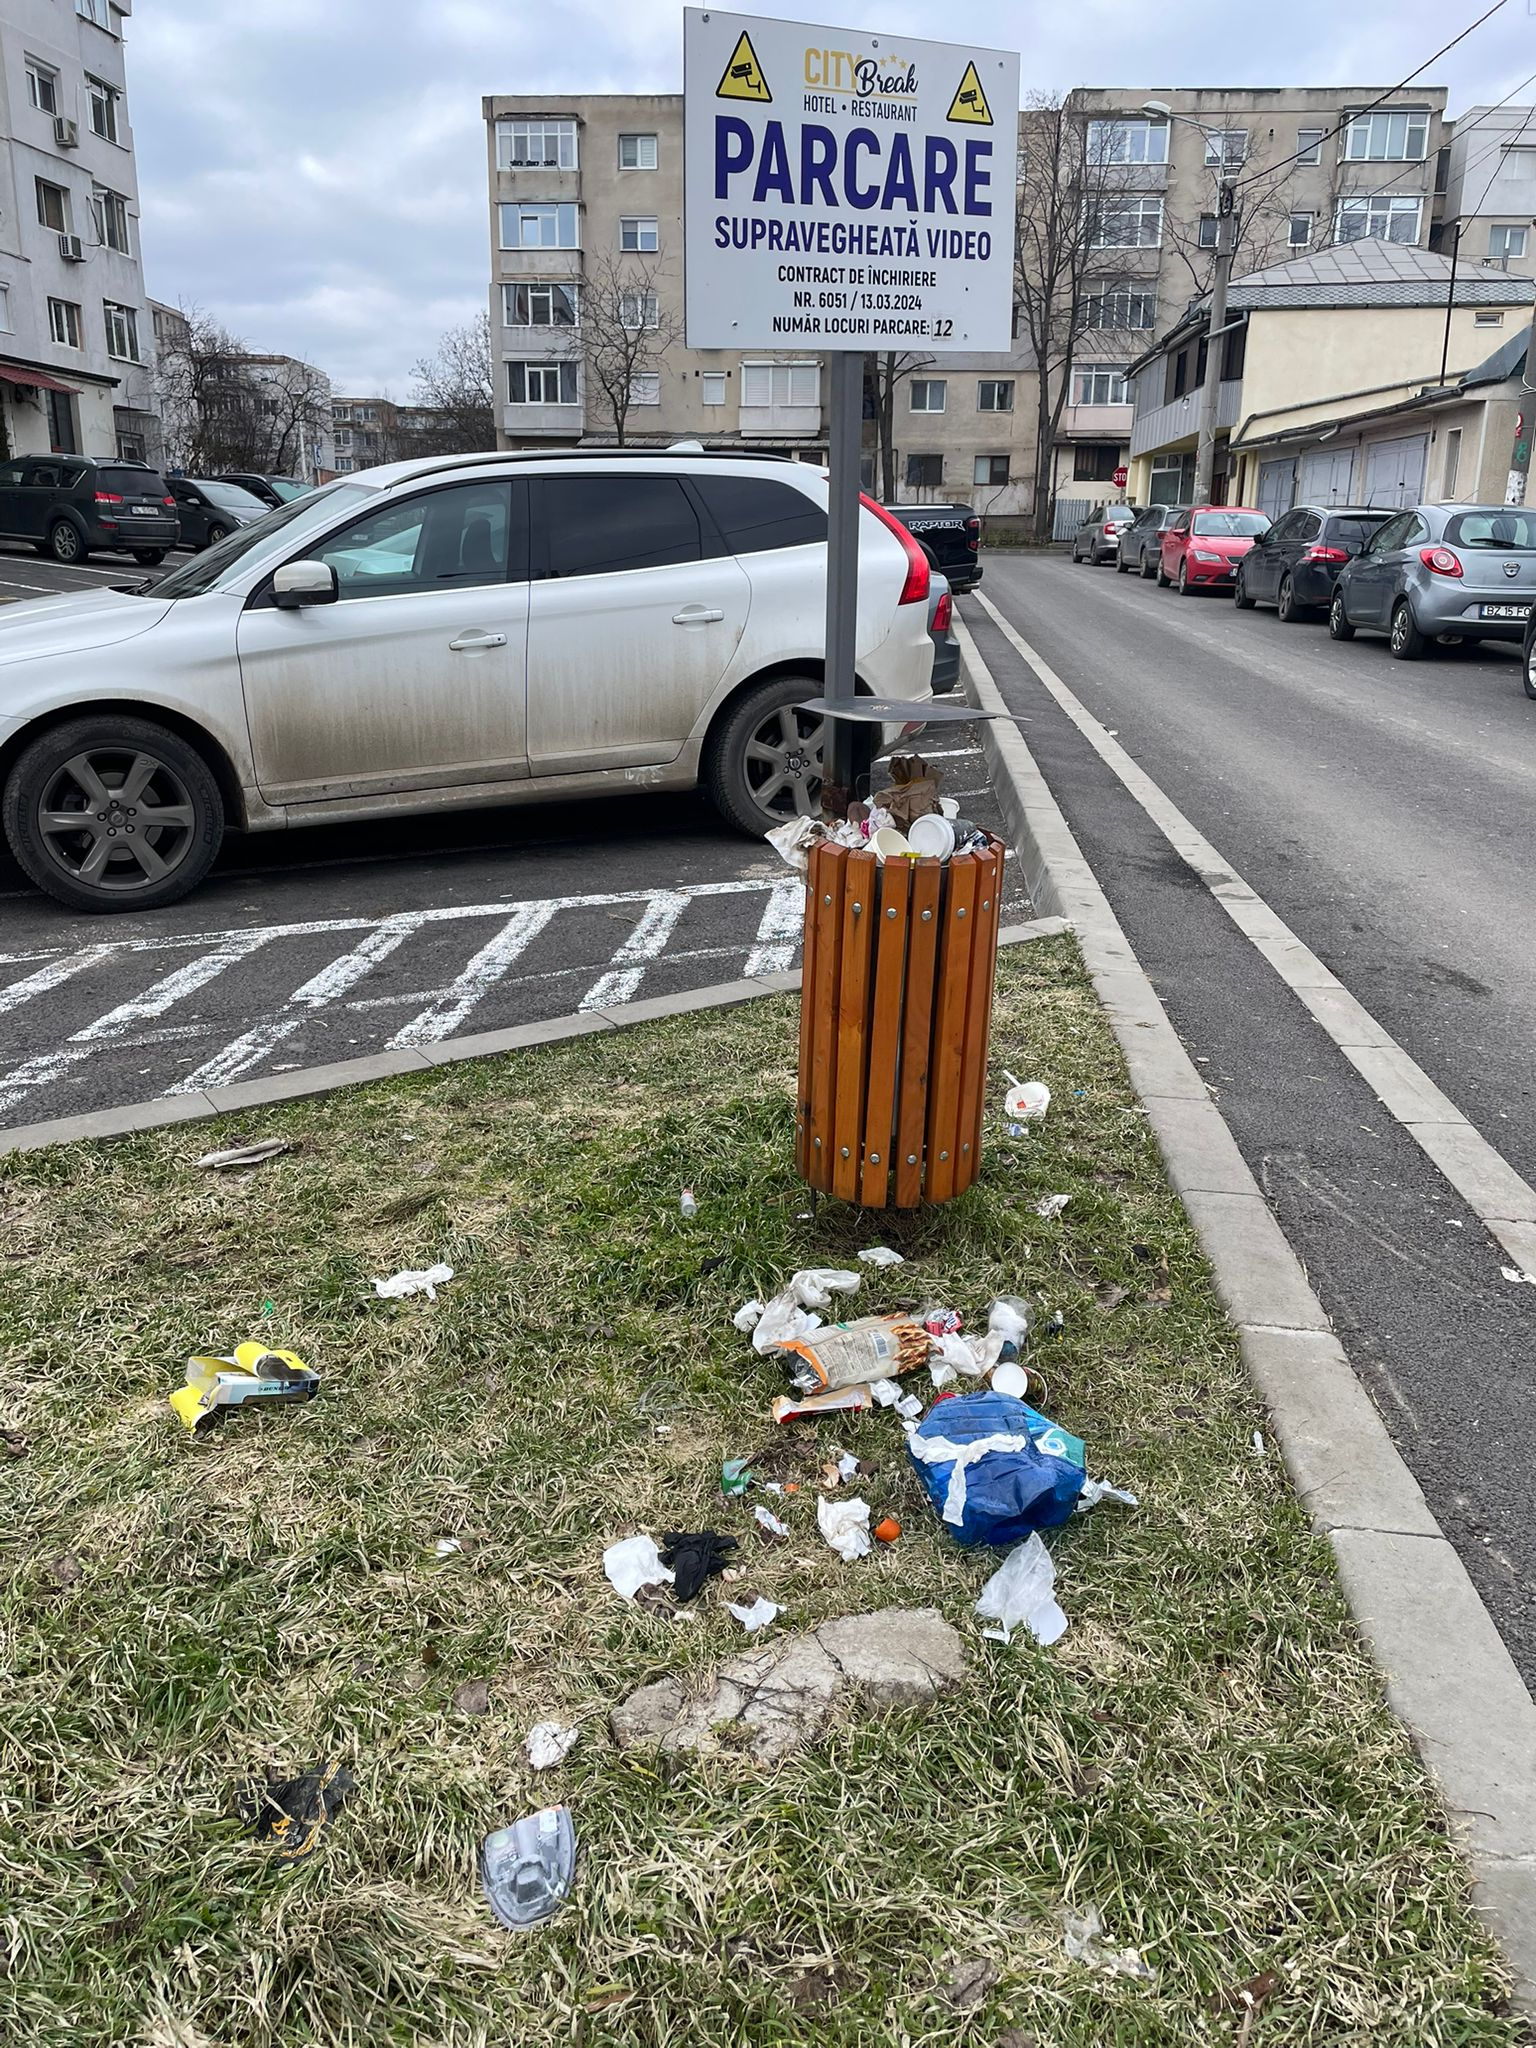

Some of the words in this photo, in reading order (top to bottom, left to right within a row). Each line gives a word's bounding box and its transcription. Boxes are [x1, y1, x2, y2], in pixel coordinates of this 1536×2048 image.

[804, 48, 863, 90] CITY
[854, 60, 919, 98] Break
[803, 95, 837, 114] HOTEL
[851, 103, 918, 122] RESTAURANT
[715, 115, 993, 217] PARCARE
[715, 216, 920, 257] SUPRAVEGHEATĂ
[927, 228, 992, 261] VIDEO
[778, 265, 845, 285] CONTRACT
[849, 269, 865, 285] DE
[868, 264, 937, 287] ÎNCHIRIERE
[793, 291, 815, 308] NR.
[819, 292, 847, 309] 6051
[850, 291, 858, 311] /
[861, 293, 922, 311] 13.03.2024
[773, 314, 821, 334] NUMĂR
[825, 317, 870, 335] LOCURI
[873, 318, 930, 336] PARCARE:
[933, 319, 953, 337] 12
[1113, 472, 1127, 482] STO
[908, 520, 966, 533] RAPTOR
[1487, 605, 1500, 616] BZ
[1504, 606, 1514, 616] 15
